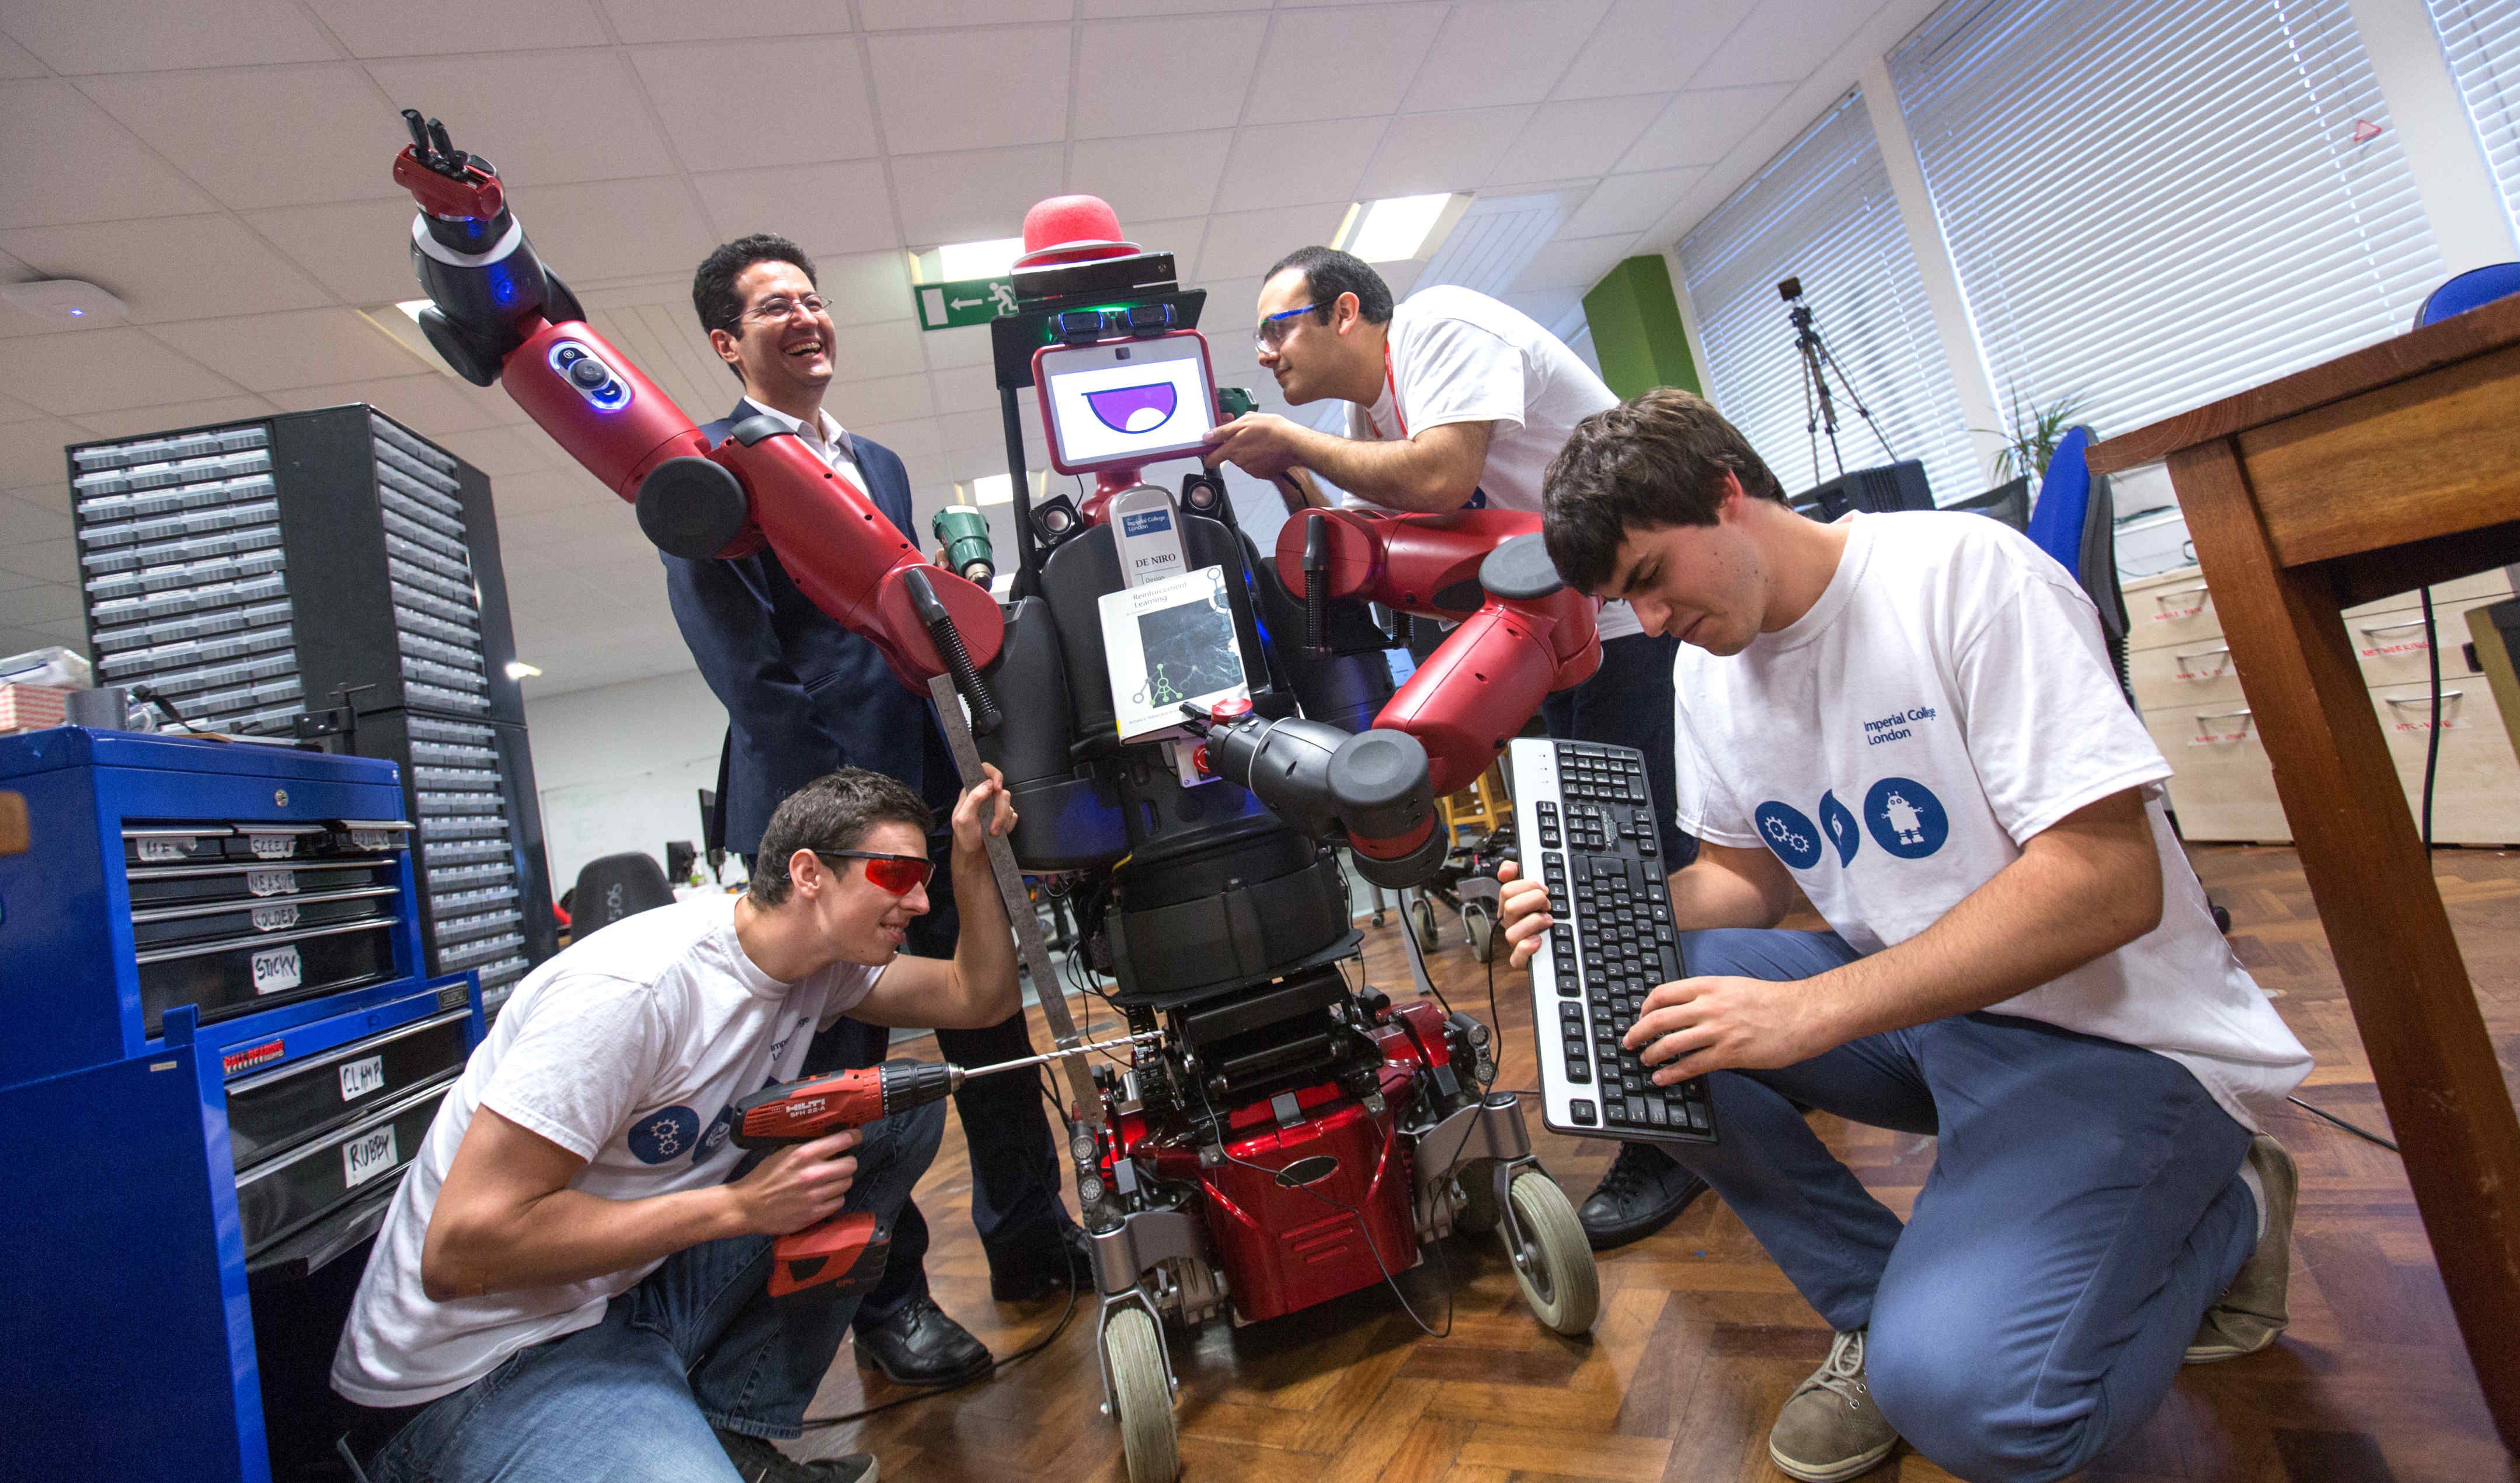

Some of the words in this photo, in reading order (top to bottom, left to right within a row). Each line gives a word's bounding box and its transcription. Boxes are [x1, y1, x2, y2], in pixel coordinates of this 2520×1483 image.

[1135, 558, 1150, 568] DE
[1151, 553, 1176, 565] NIRO
[1133, 582, 1186, 600] Reinforcement
[1134, 596, 1167, 607] Learning
[1864, 712, 1906, 732] Imperial
[1867, 729, 1912, 745] London
[256, 954, 296, 980] STICKY
[343, 1063, 380, 1092] CLAMP
[786, 1098, 825, 1113] HILTI
[350, 1134, 391, 1172] RUBBY
